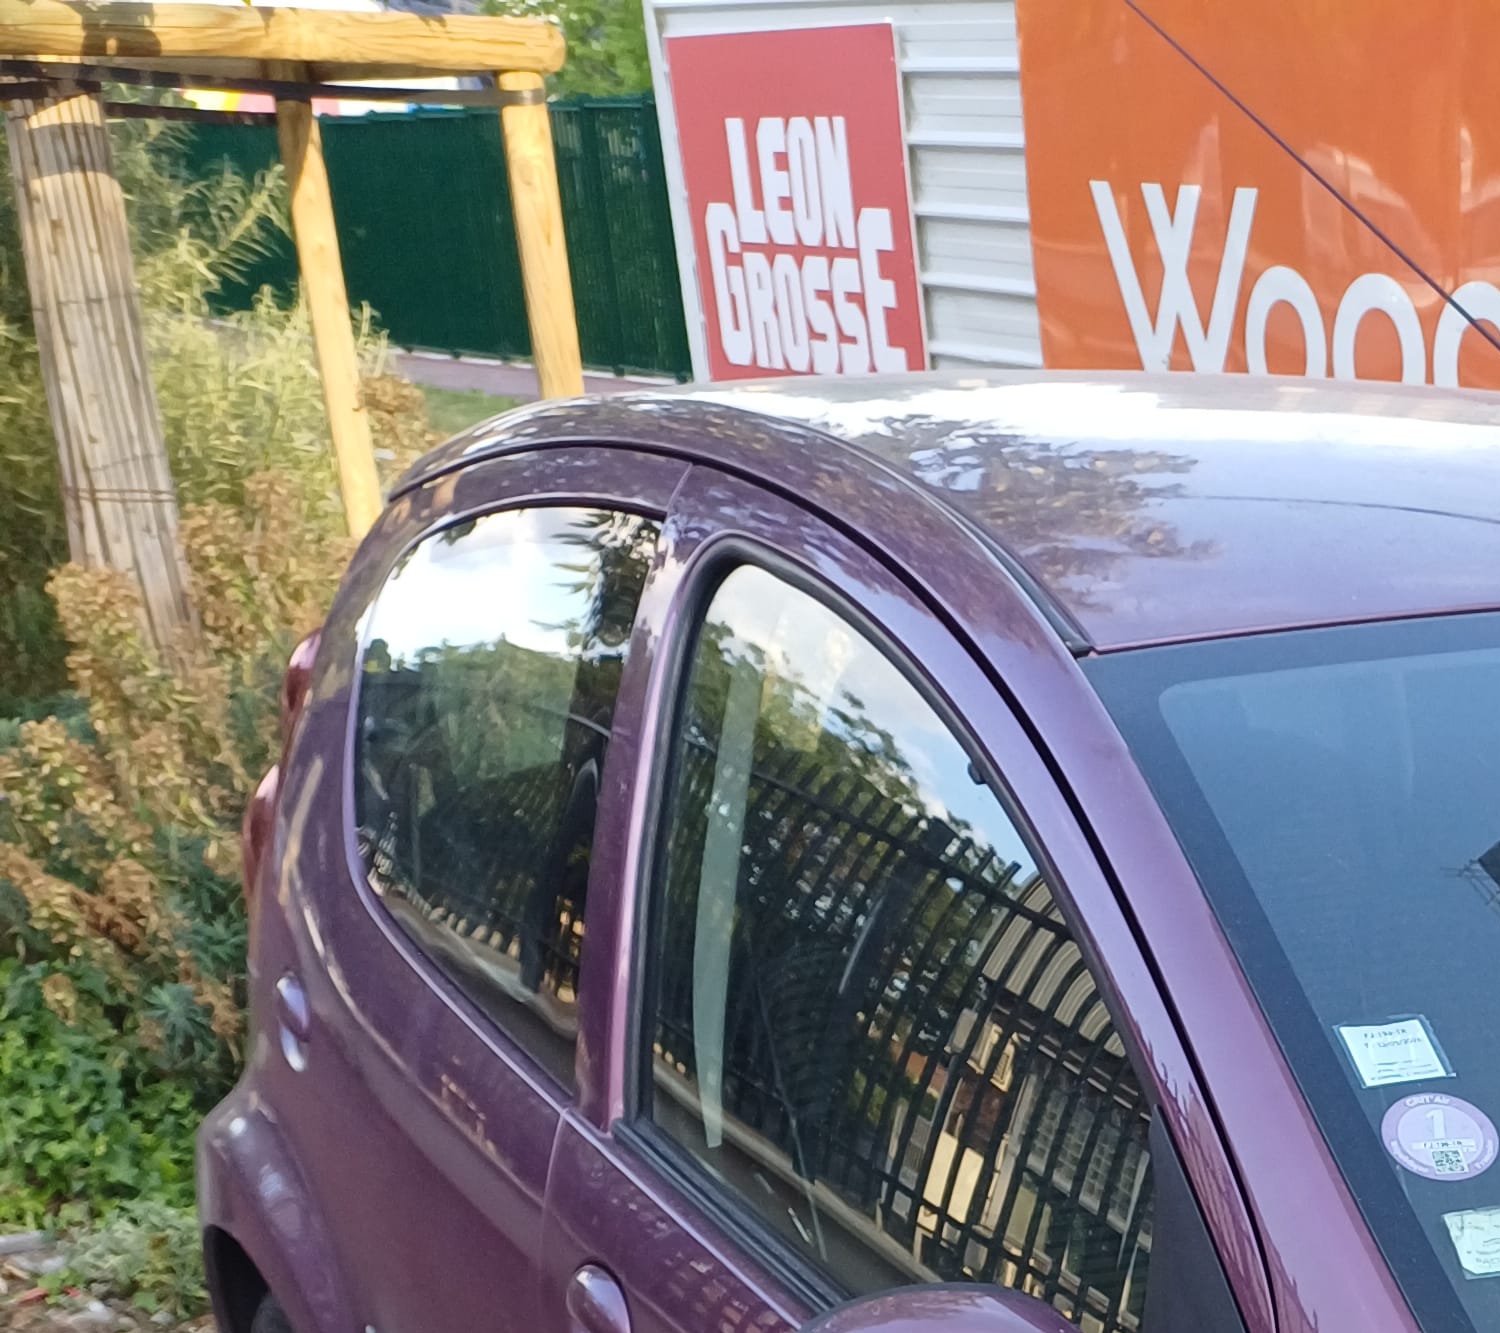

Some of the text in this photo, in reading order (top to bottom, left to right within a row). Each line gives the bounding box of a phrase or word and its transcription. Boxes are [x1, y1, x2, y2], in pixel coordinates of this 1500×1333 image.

[724, 115, 856, 249] LEON
[704, 201, 908, 375] GROSSE
[1424, 1109, 1446, 1139] 1
